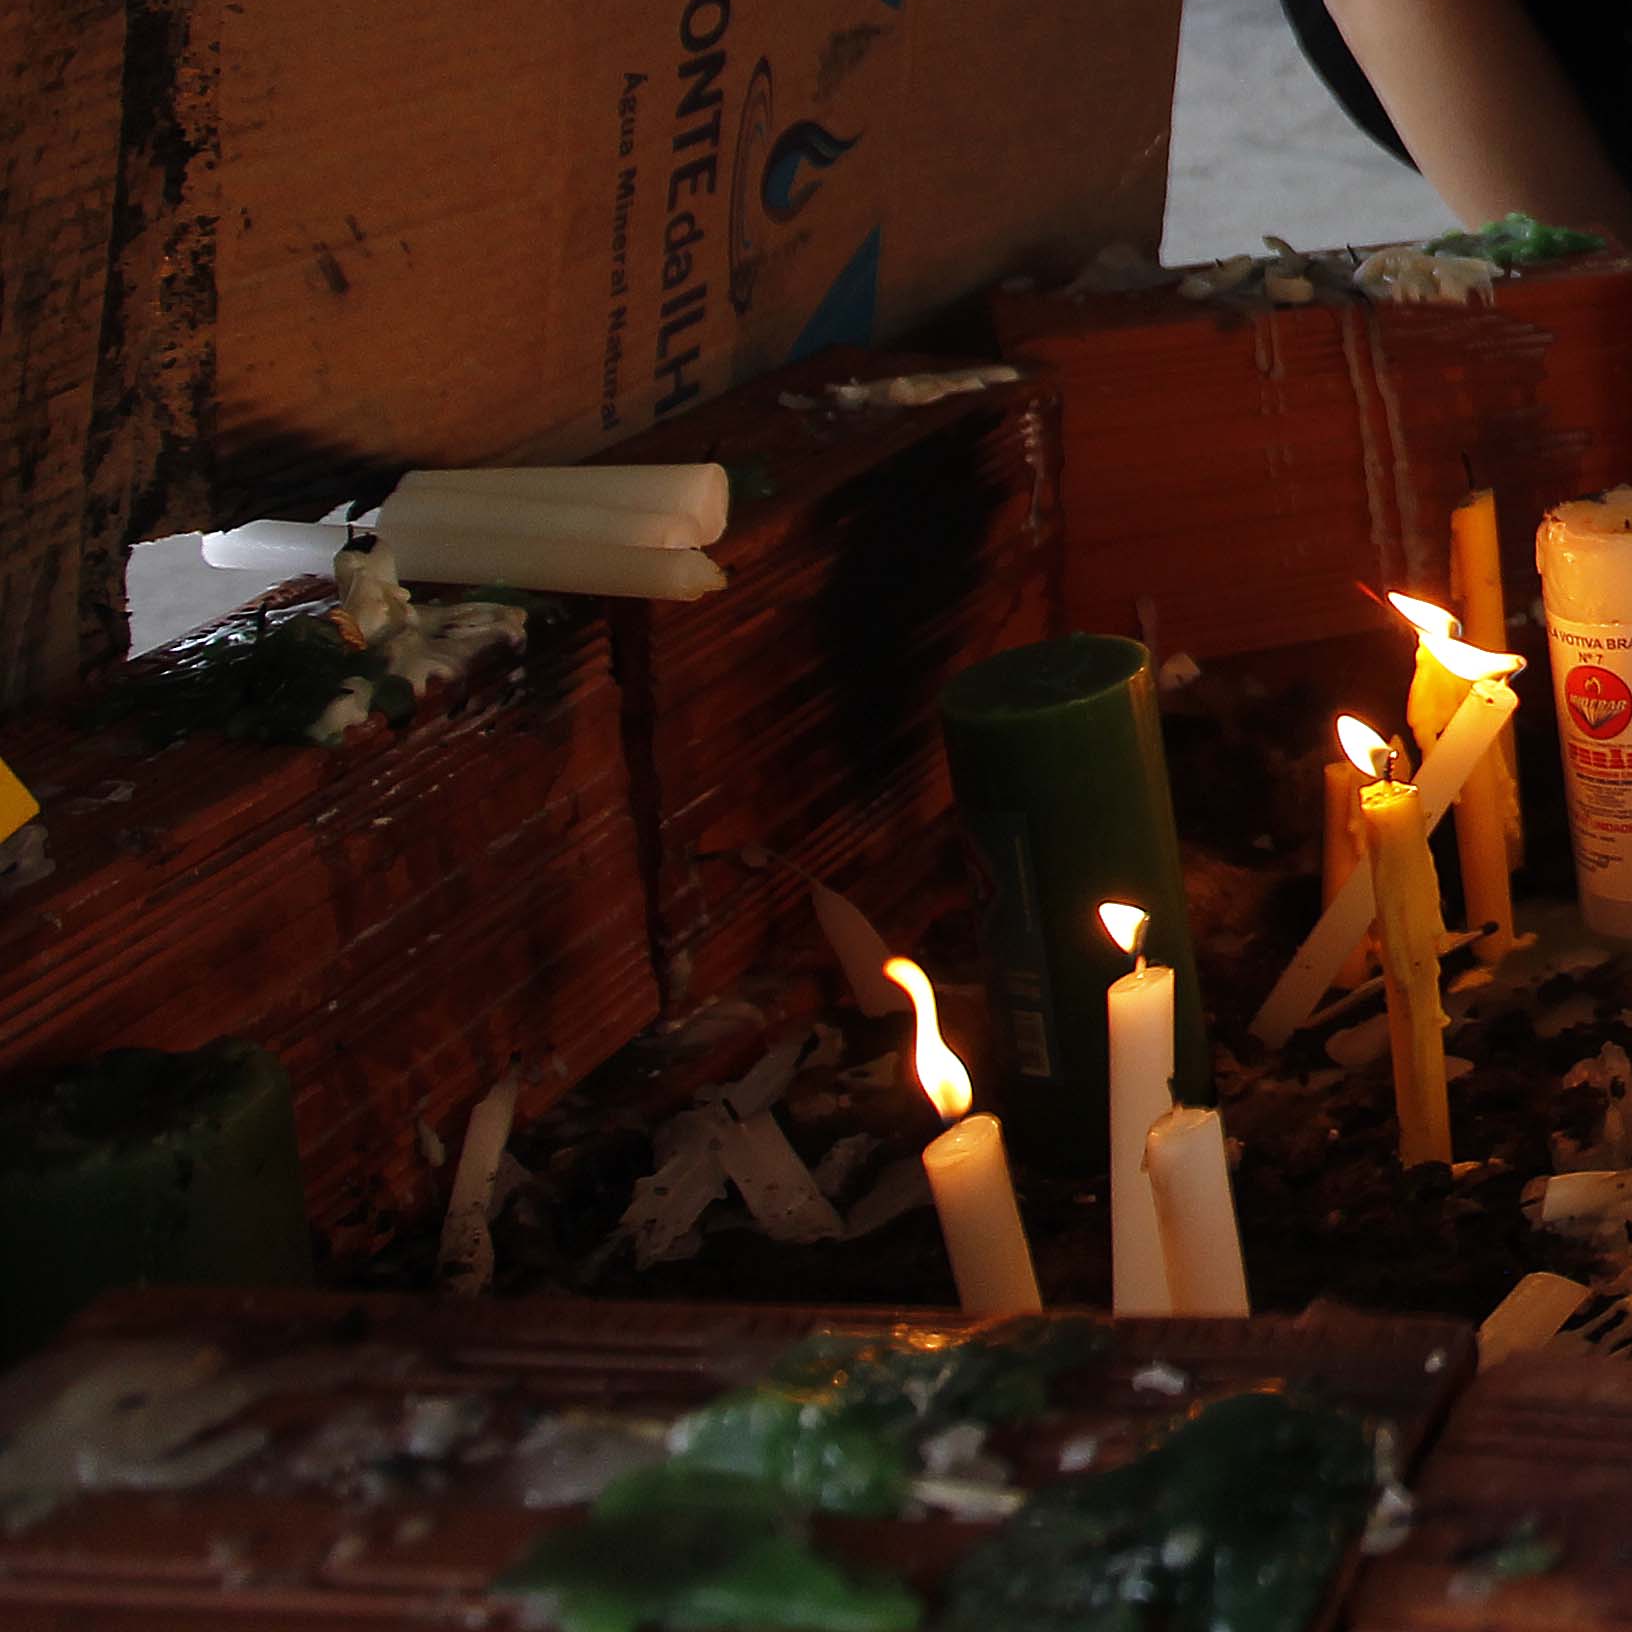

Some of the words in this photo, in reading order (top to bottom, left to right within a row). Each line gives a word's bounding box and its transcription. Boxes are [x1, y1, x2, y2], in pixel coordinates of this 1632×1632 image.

[618, 72, 648, 156] Água
[610, 168, 637, 297] Mineral
[601, 308, 627, 431] Natural
[1559, 631, 1602, 649] VOTIVA
